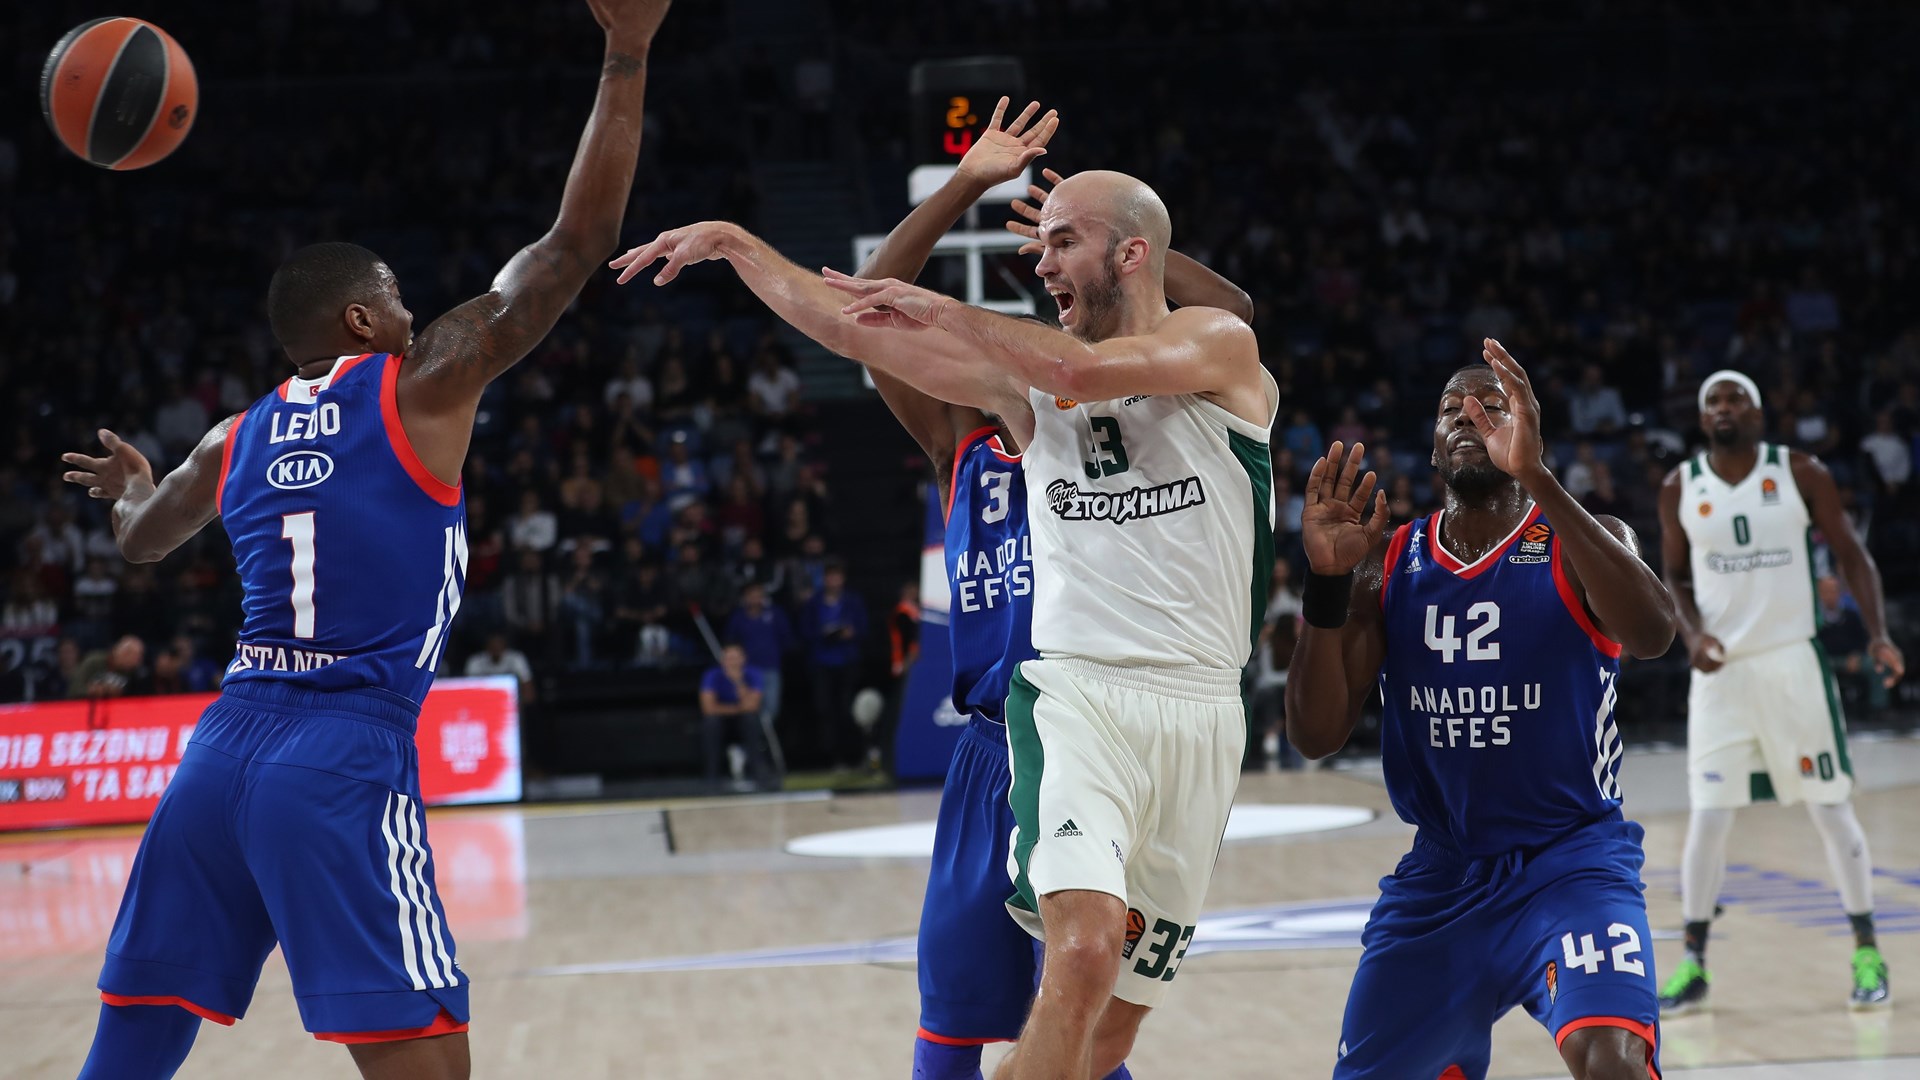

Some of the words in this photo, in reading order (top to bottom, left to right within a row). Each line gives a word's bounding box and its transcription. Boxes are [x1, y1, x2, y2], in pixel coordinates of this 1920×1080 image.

[269, 402, 341, 445] LEDO
[277, 458, 323, 484] KIA
[980, 471, 1012, 525] 3
[1733, 515, 1750, 546] 0
[281, 511, 317, 639] 1
[951, 535, 1032, 583] NADOL
[1424, 601, 1500, 664] 42
[1410, 683, 1541, 714] ANADOLU
[1429, 715, 1511, 748] EFES
[1053, 829, 1084, 838] adidas
[1561, 922, 1646, 977] 42
